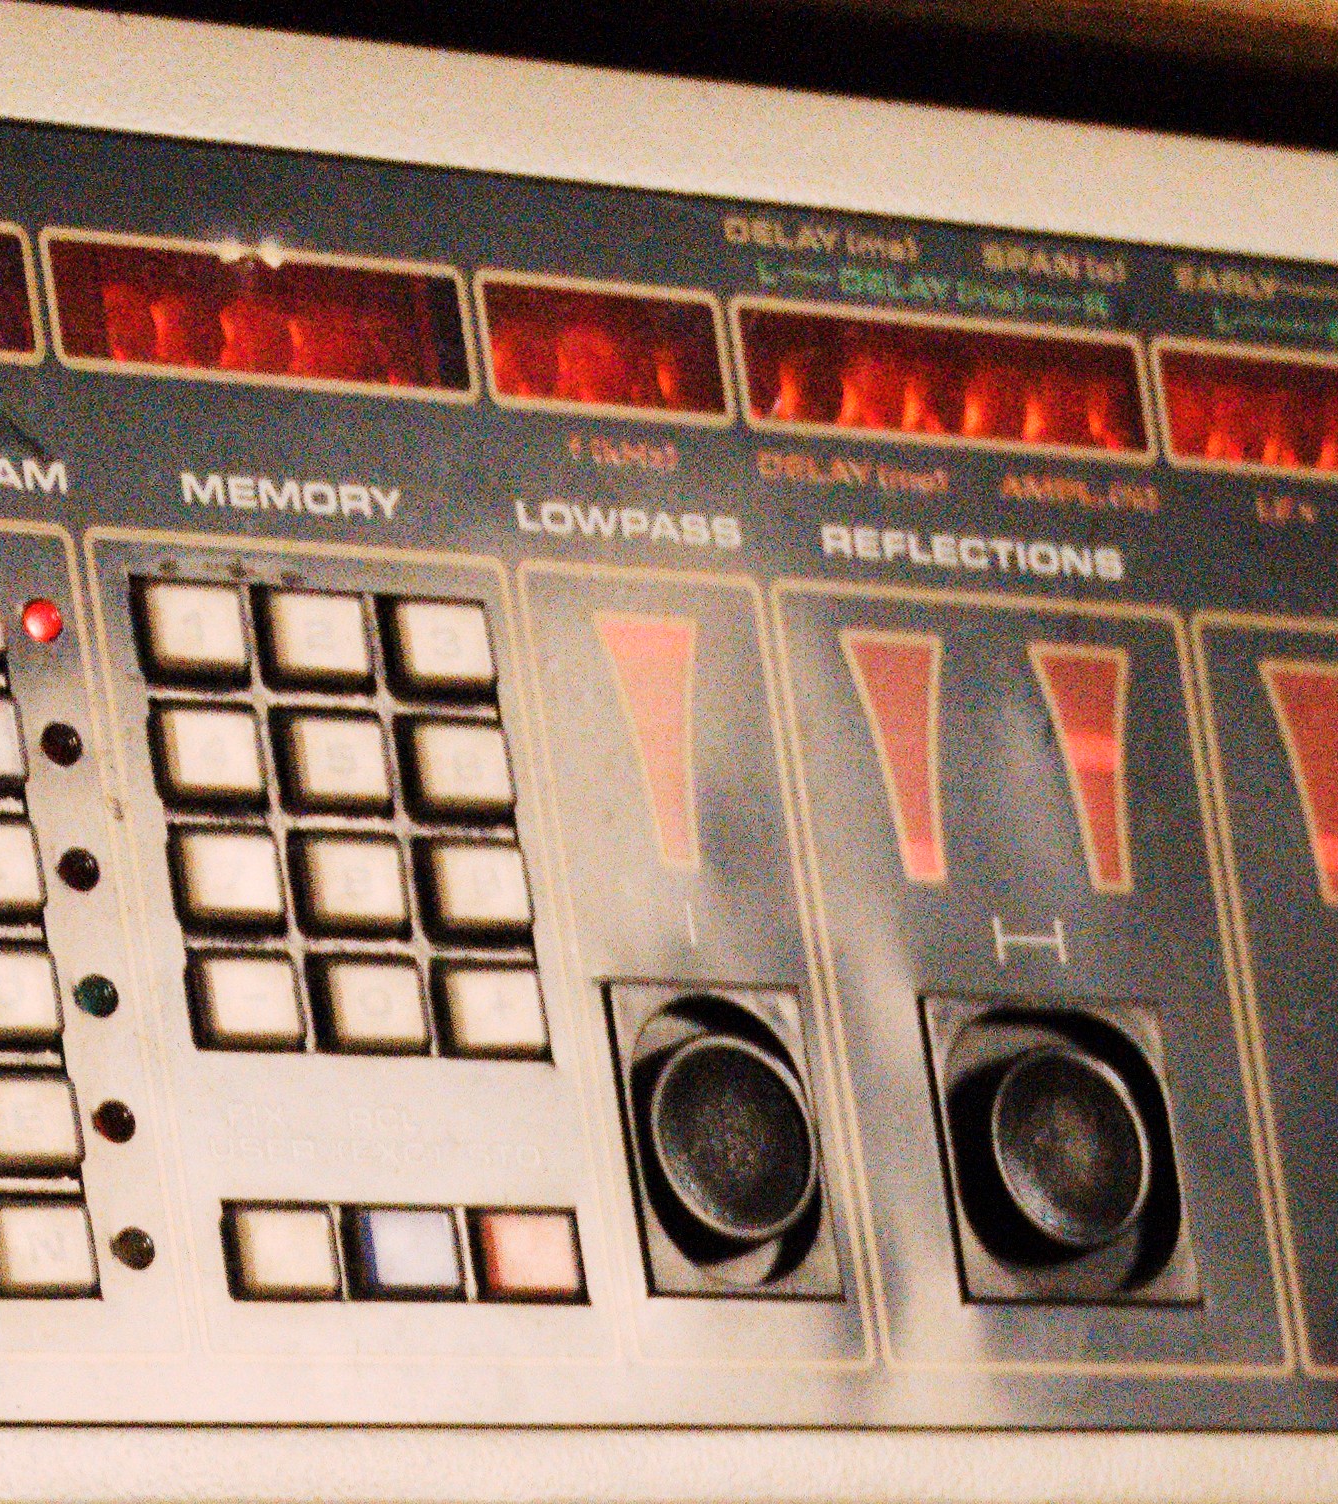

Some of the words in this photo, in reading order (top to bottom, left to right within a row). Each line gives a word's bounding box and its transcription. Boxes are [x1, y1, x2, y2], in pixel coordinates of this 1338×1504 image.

[180, 471, 401, 520] MEMORY
[516, 500, 742, 551] LOWPASS
[820, 522, 1124, 580] REFLECTIONS
